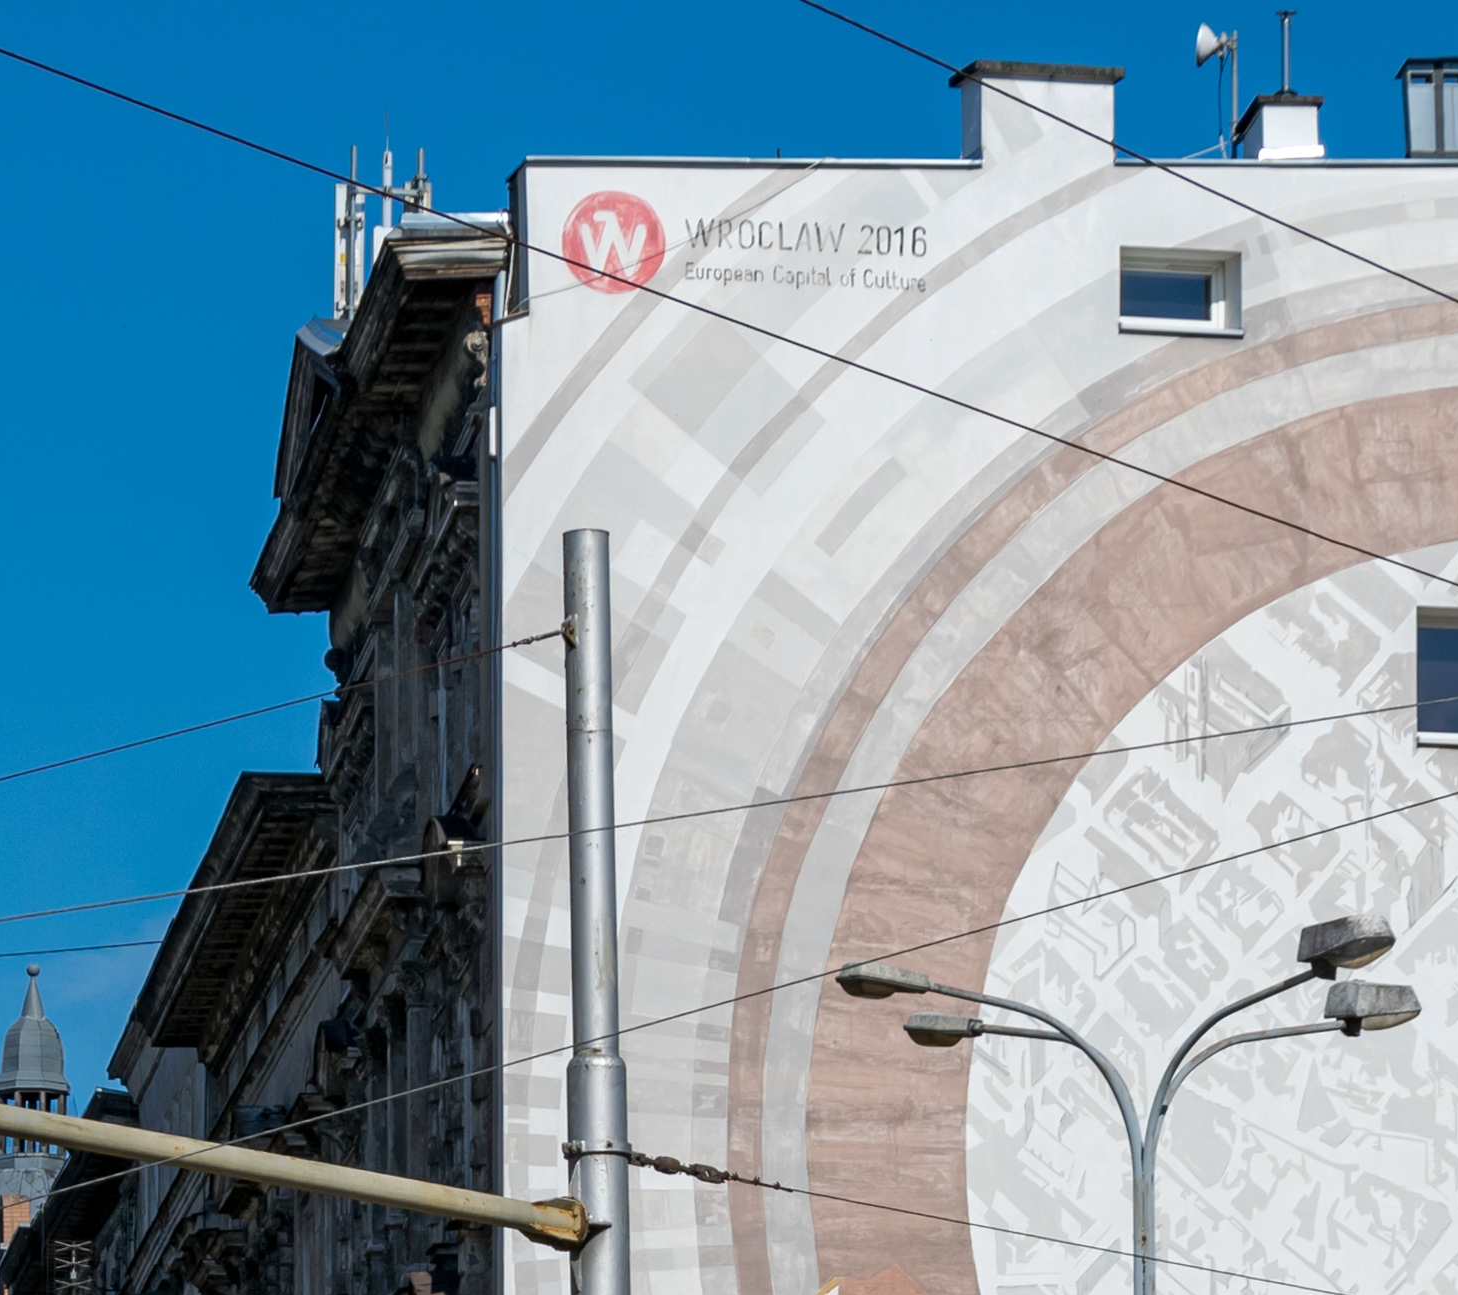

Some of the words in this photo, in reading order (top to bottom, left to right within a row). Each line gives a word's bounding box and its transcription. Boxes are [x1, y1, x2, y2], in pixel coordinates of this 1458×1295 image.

[857, 223, 927, 258] 2016
[685, 262, 764, 286] European
[773, 265, 832, 290] Capital
[840, 267, 856, 288] of
[864, 269, 927, 293] Culture
